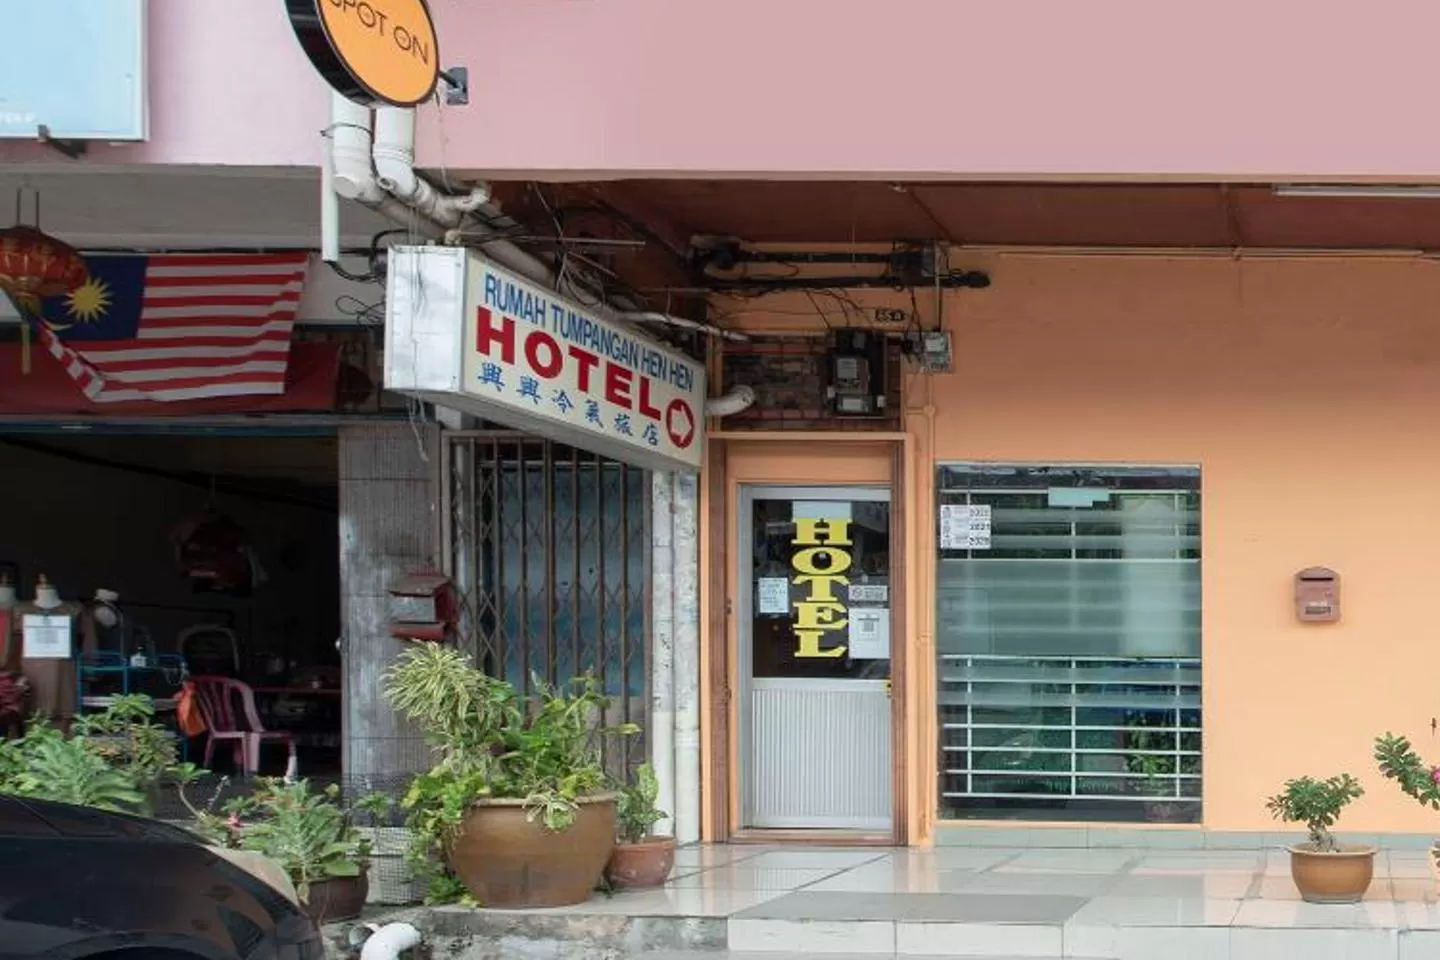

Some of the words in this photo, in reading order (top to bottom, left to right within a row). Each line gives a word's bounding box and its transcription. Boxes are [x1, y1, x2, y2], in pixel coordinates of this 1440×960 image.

[393, 25, 429, 64] ON
[476, 305, 661, 421] HOTEL
[485, 272, 546, 328] RUMAH
[551, 303, 639, 369] TUMPANGAN
[641, 348, 667, 381] HEN
[669, 362, 694, 392] HEN
[792, 517, 852, 658] HOTEL
